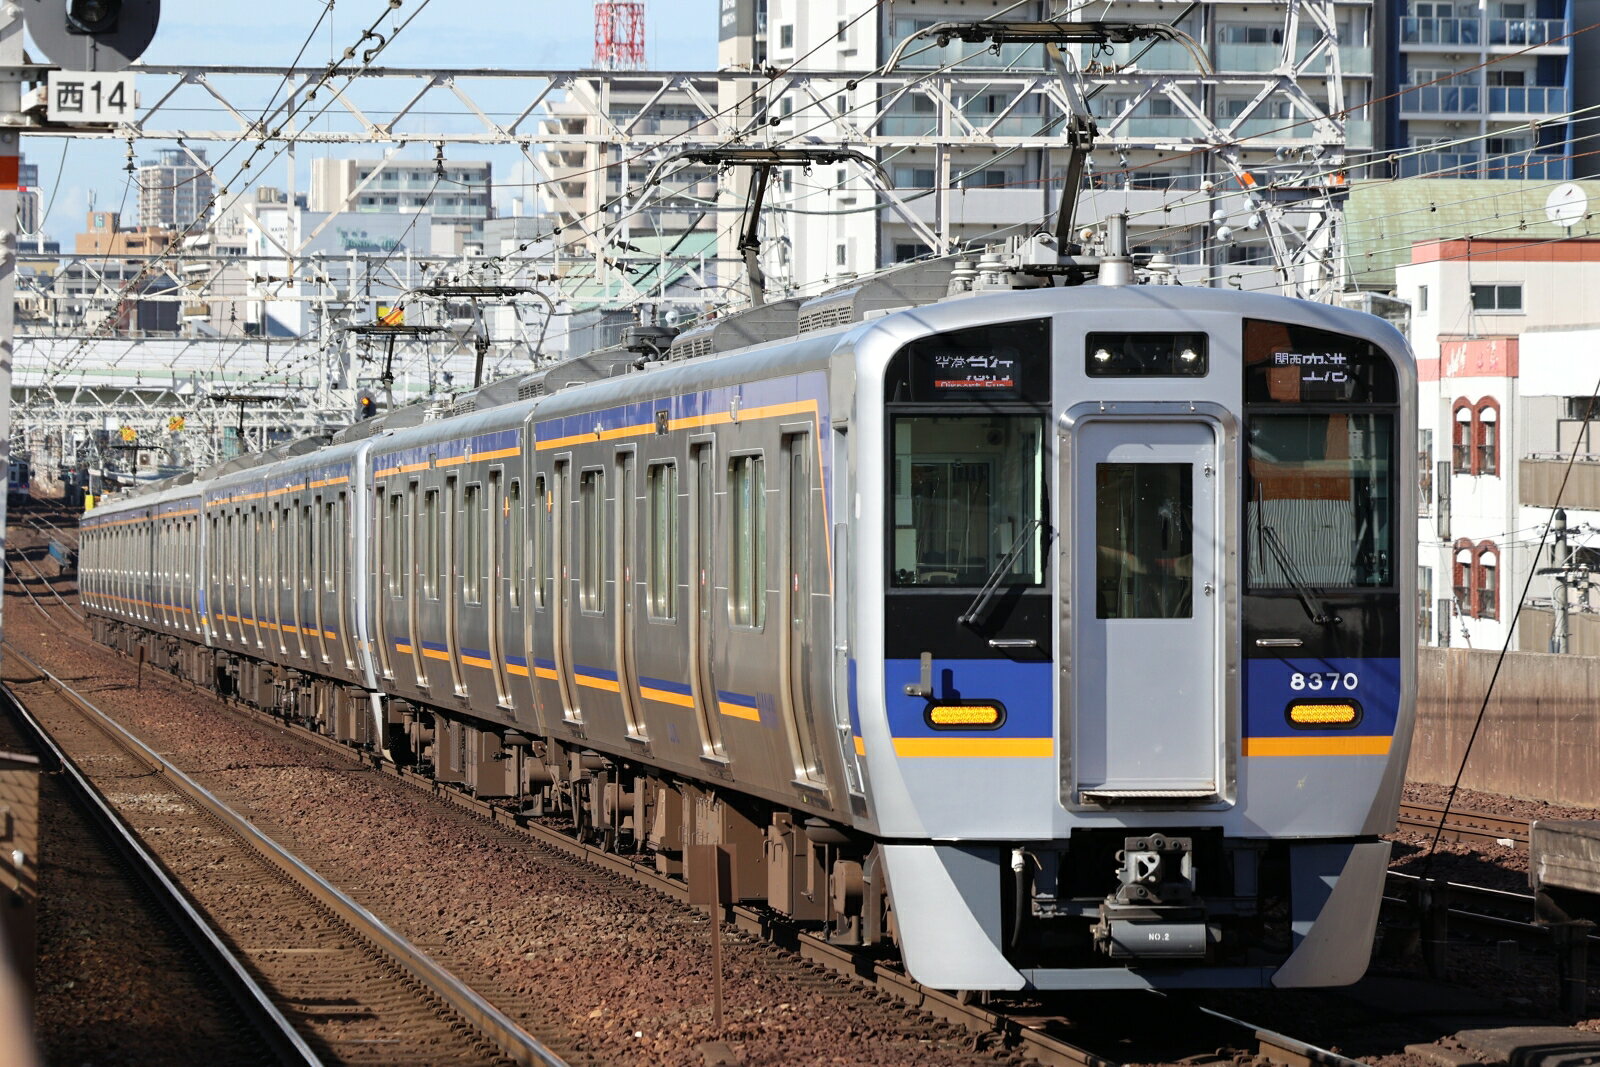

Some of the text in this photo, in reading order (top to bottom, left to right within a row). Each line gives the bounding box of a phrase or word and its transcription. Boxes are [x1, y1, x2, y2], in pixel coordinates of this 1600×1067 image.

[56, 80, 127, 115] 西14
[1290, 672, 1358, 691] 8370
[1148, 932, 1170, 941] NO.2
